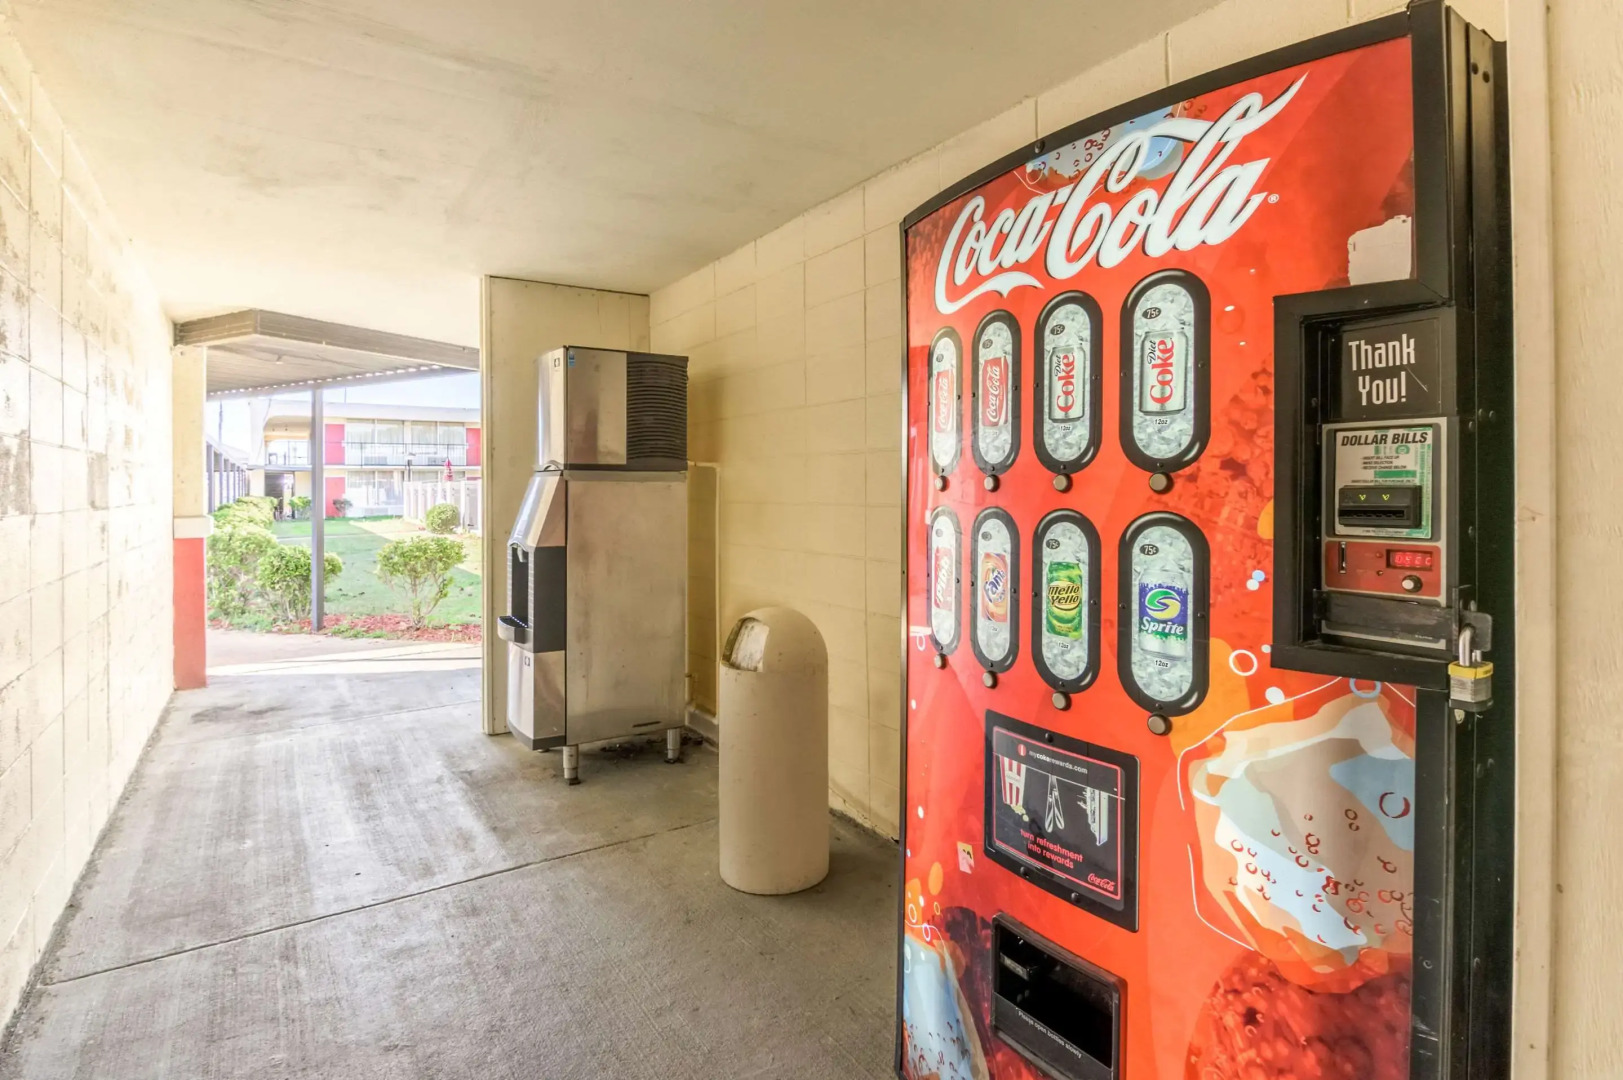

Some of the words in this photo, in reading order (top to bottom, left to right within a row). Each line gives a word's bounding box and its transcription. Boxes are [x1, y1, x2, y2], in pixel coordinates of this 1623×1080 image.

[933, 73, 1308, 315] Coca-Cola
[1146, 307, 1160, 319] 75¢
[1146, 339, 1158, 365] Diet
[1348, 333, 1416, 371] Thank
[1054, 354, 1063, 377] Diet
[1150, 338, 1175, 405] Coke
[1056, 352, 1075, 413] Coke
[1358, 370, 1408, 406] You!
[1154, 417, 1170, 426] 12oz
[1341, 433, 1388, 447] DOLLAR
[1391, 431, 1429, 445] BILLS
[1048, 582, 1081, 597] Mello
[1050, 593, 1080, 607] Yello
[1140, 616, 1185, 637] Sprite
[1154, 659, 1170, 668] 12oz
[1020, 828, 1035, 842] turn
[1037, 836, 1084, 863] refreshment
[1027, 842, 1042, 855] into
[1043, 849, 1074, 869] rewards
